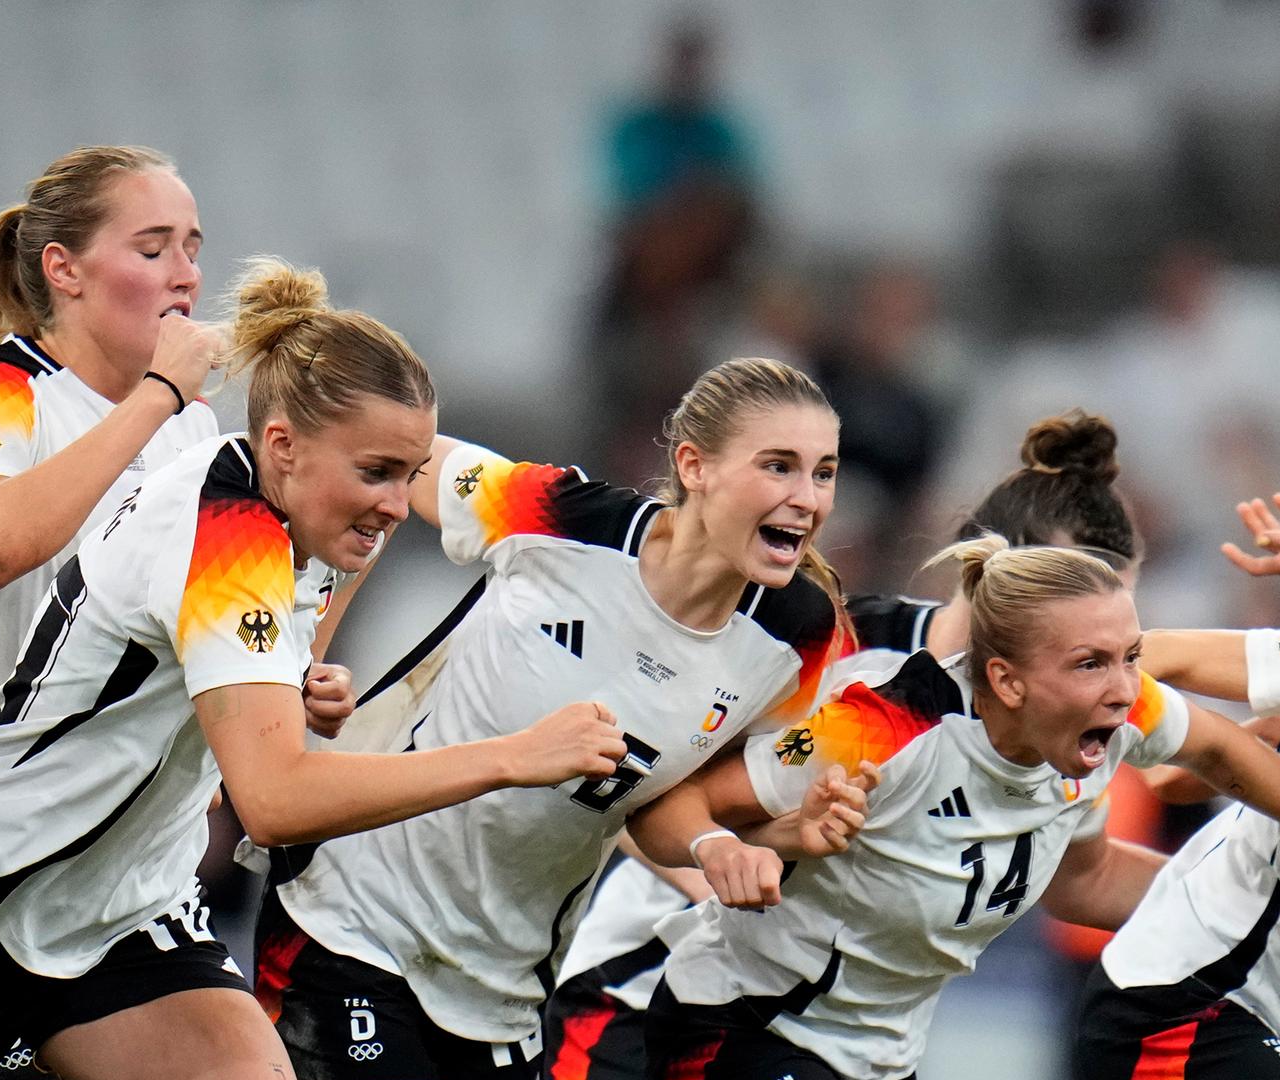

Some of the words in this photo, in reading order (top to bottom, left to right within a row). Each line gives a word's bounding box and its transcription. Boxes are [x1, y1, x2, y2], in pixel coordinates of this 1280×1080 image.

[714, 687, 740, 702] TEAM
[701, 702, 728, 733] D
[568, 731, 662, 814] 6
[954, 831, 1036, 928] 14
[344, 998, 375, 1008] TEA
[350, 1009, 377, 1041] D
